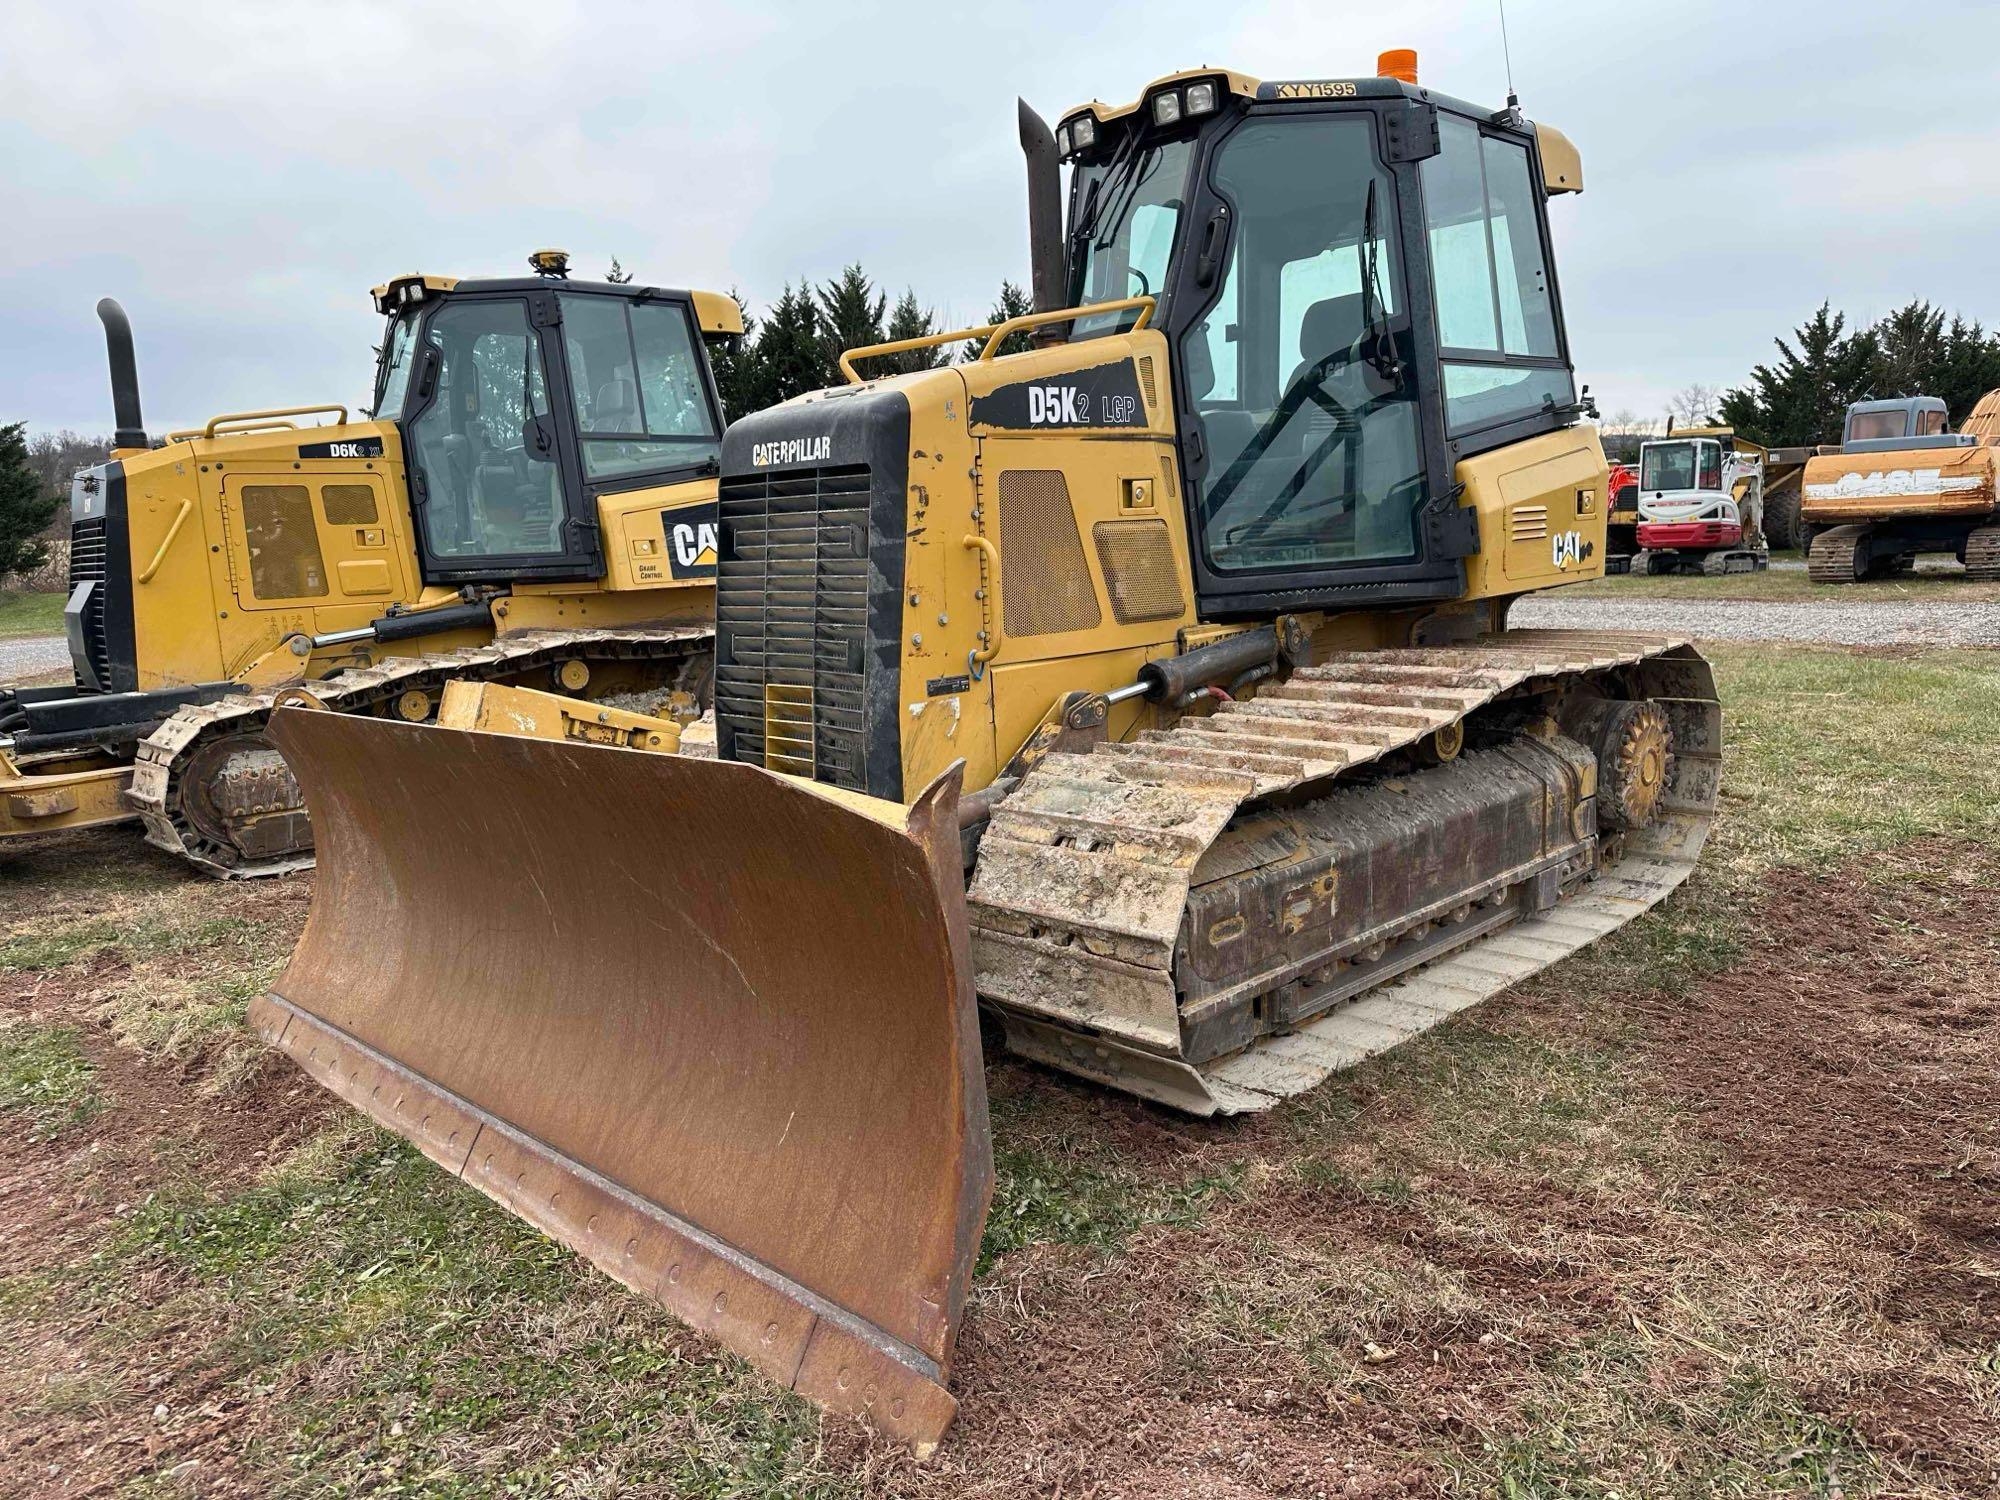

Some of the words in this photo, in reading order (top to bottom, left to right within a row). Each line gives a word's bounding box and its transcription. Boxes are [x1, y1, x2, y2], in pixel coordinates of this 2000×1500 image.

[1276, 83, 1356, 97] KYY1595
[1028, 386, 1090, 424] D5K2
[1101, 395, 1136, 423] LGP
[330, 443, 365, 457] D6K2
[752, 436, 831, 467] CATERPILLAR
[673, 523, 718, 567] CA
